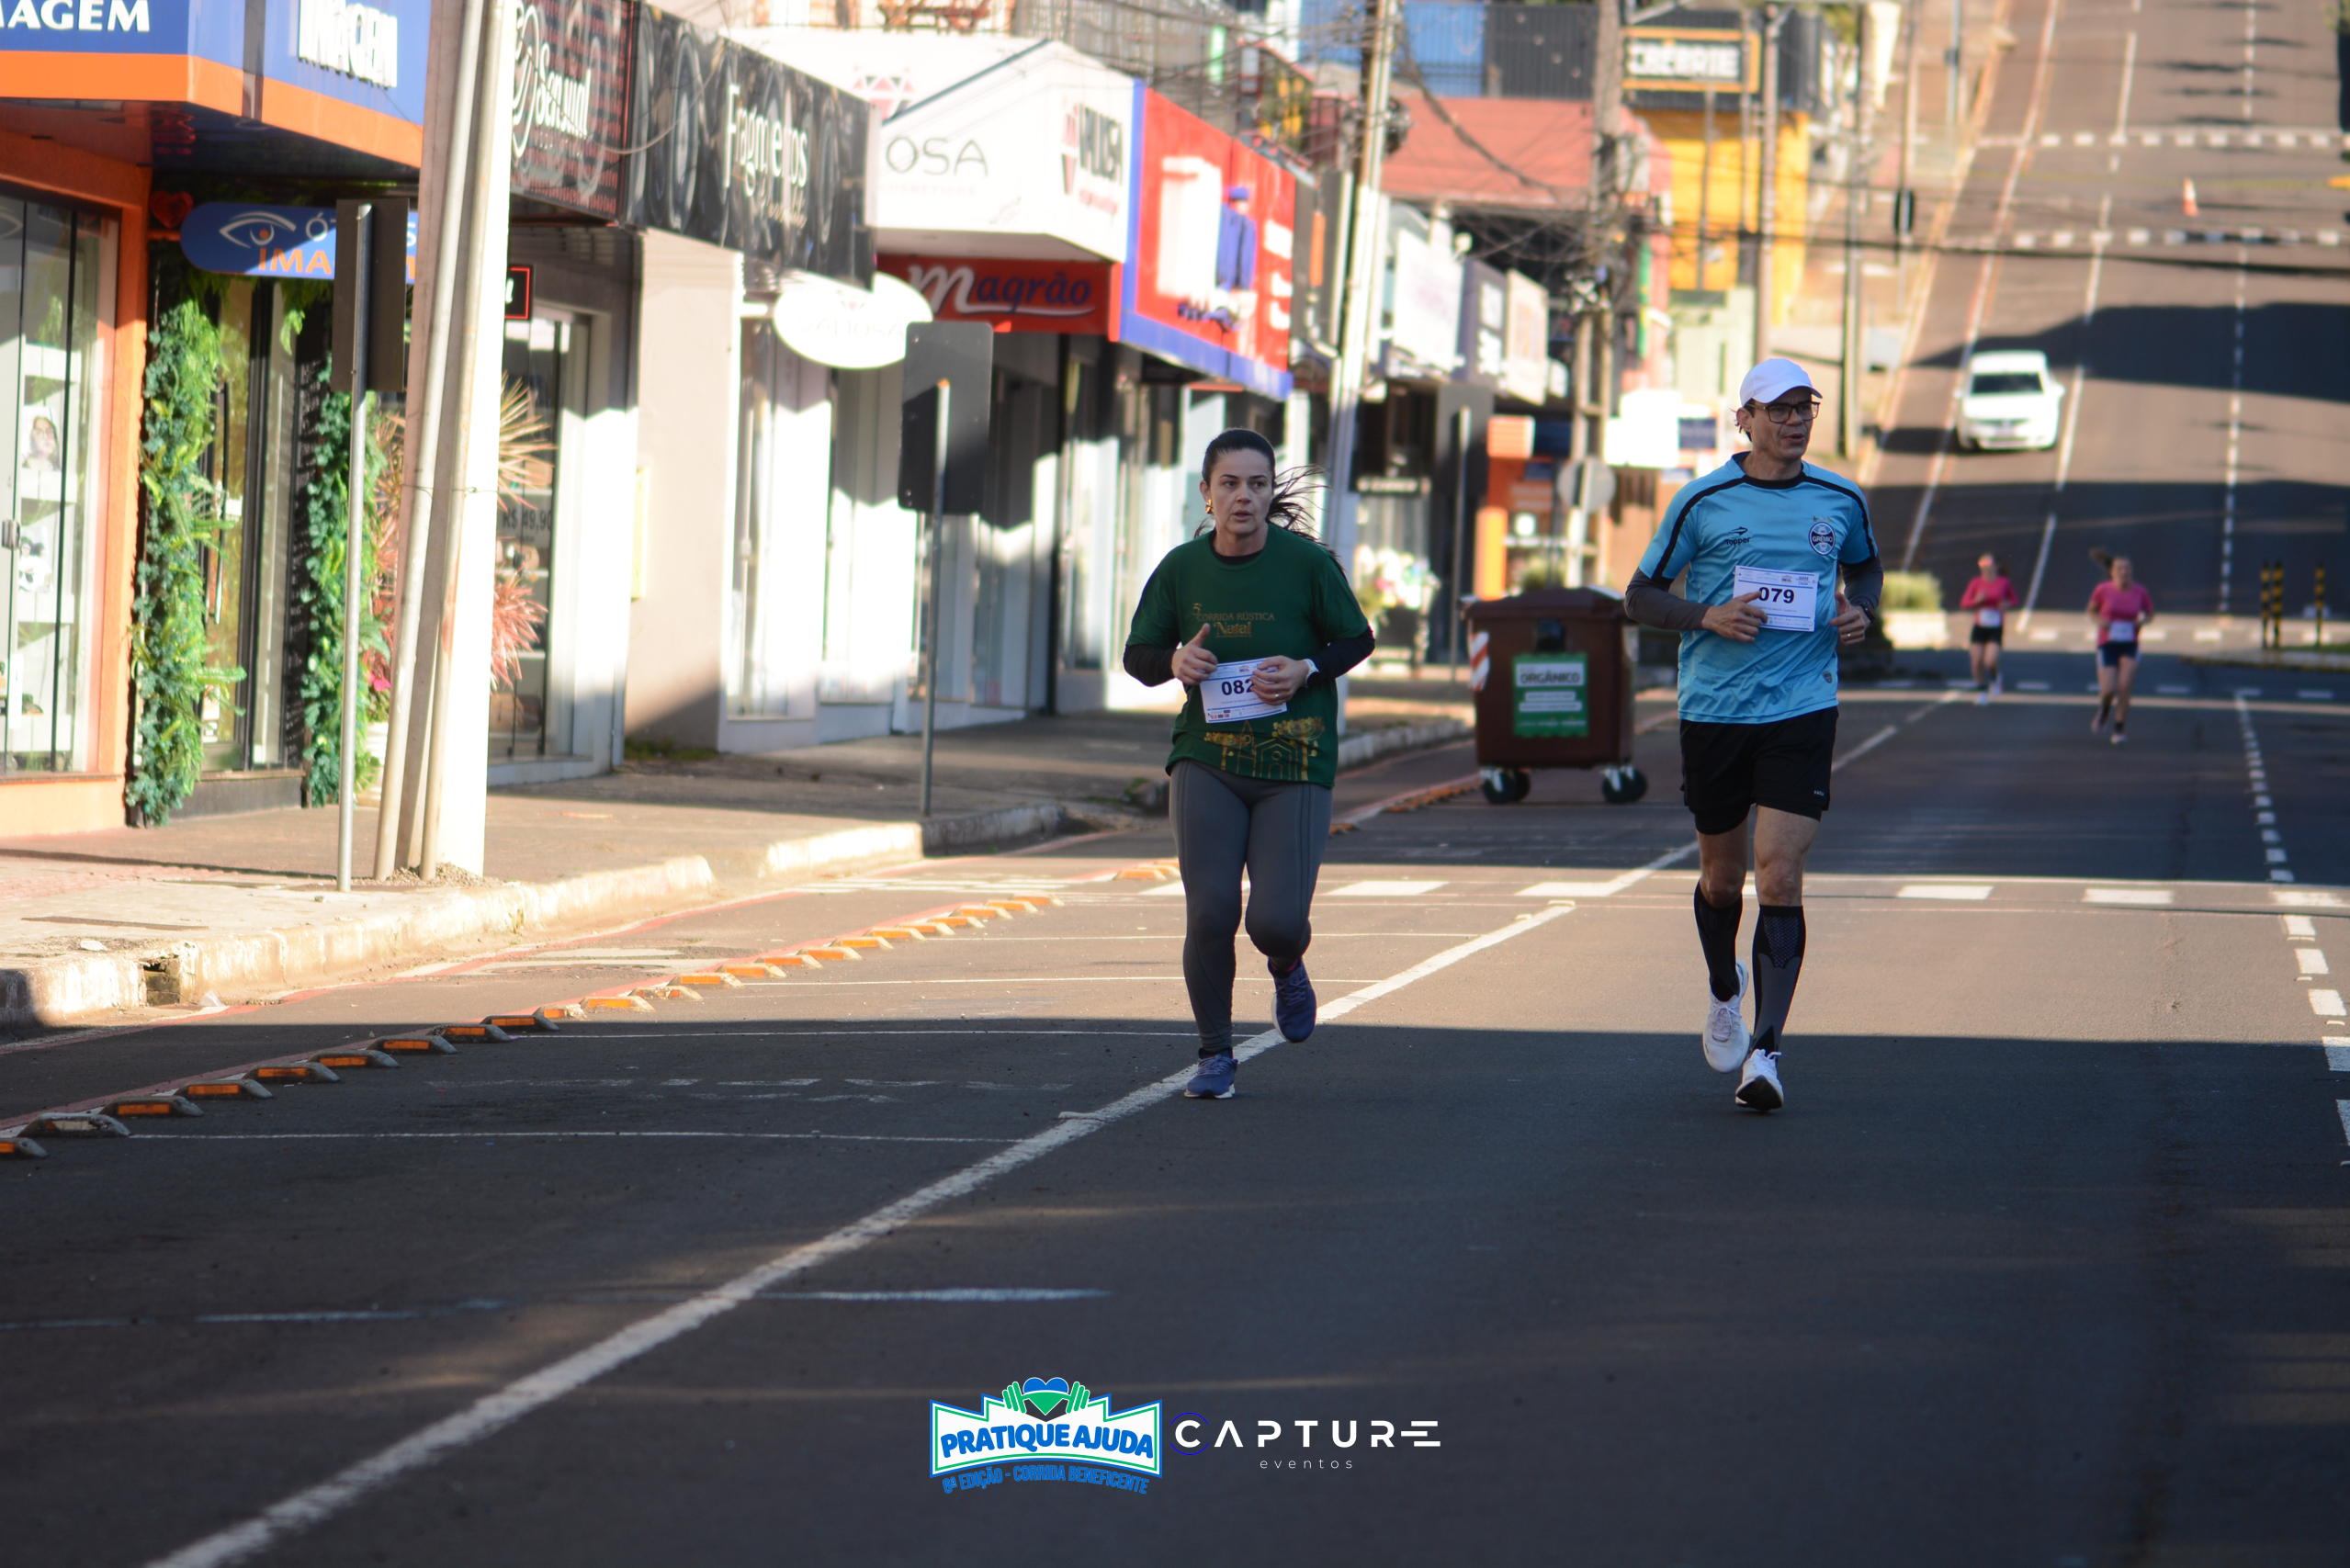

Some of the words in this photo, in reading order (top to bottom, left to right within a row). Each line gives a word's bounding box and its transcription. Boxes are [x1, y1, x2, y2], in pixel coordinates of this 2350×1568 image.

[0, 0, 150, 31] AGEM
[908, 264, 1092, 314] Magrão
[1725, 536, 1751, 547] Topper
[1758, 586, 1795, 604] 079
[1196, 612, 1235, 622] CORRIDA
[1237, 610, 1276, 622] RÚSTICA
[1214, 621, 1252, 635] Natal
[1520, 671, 1580, 684] ORGÂNICO
[1221, 678, 1255, 695] 082
